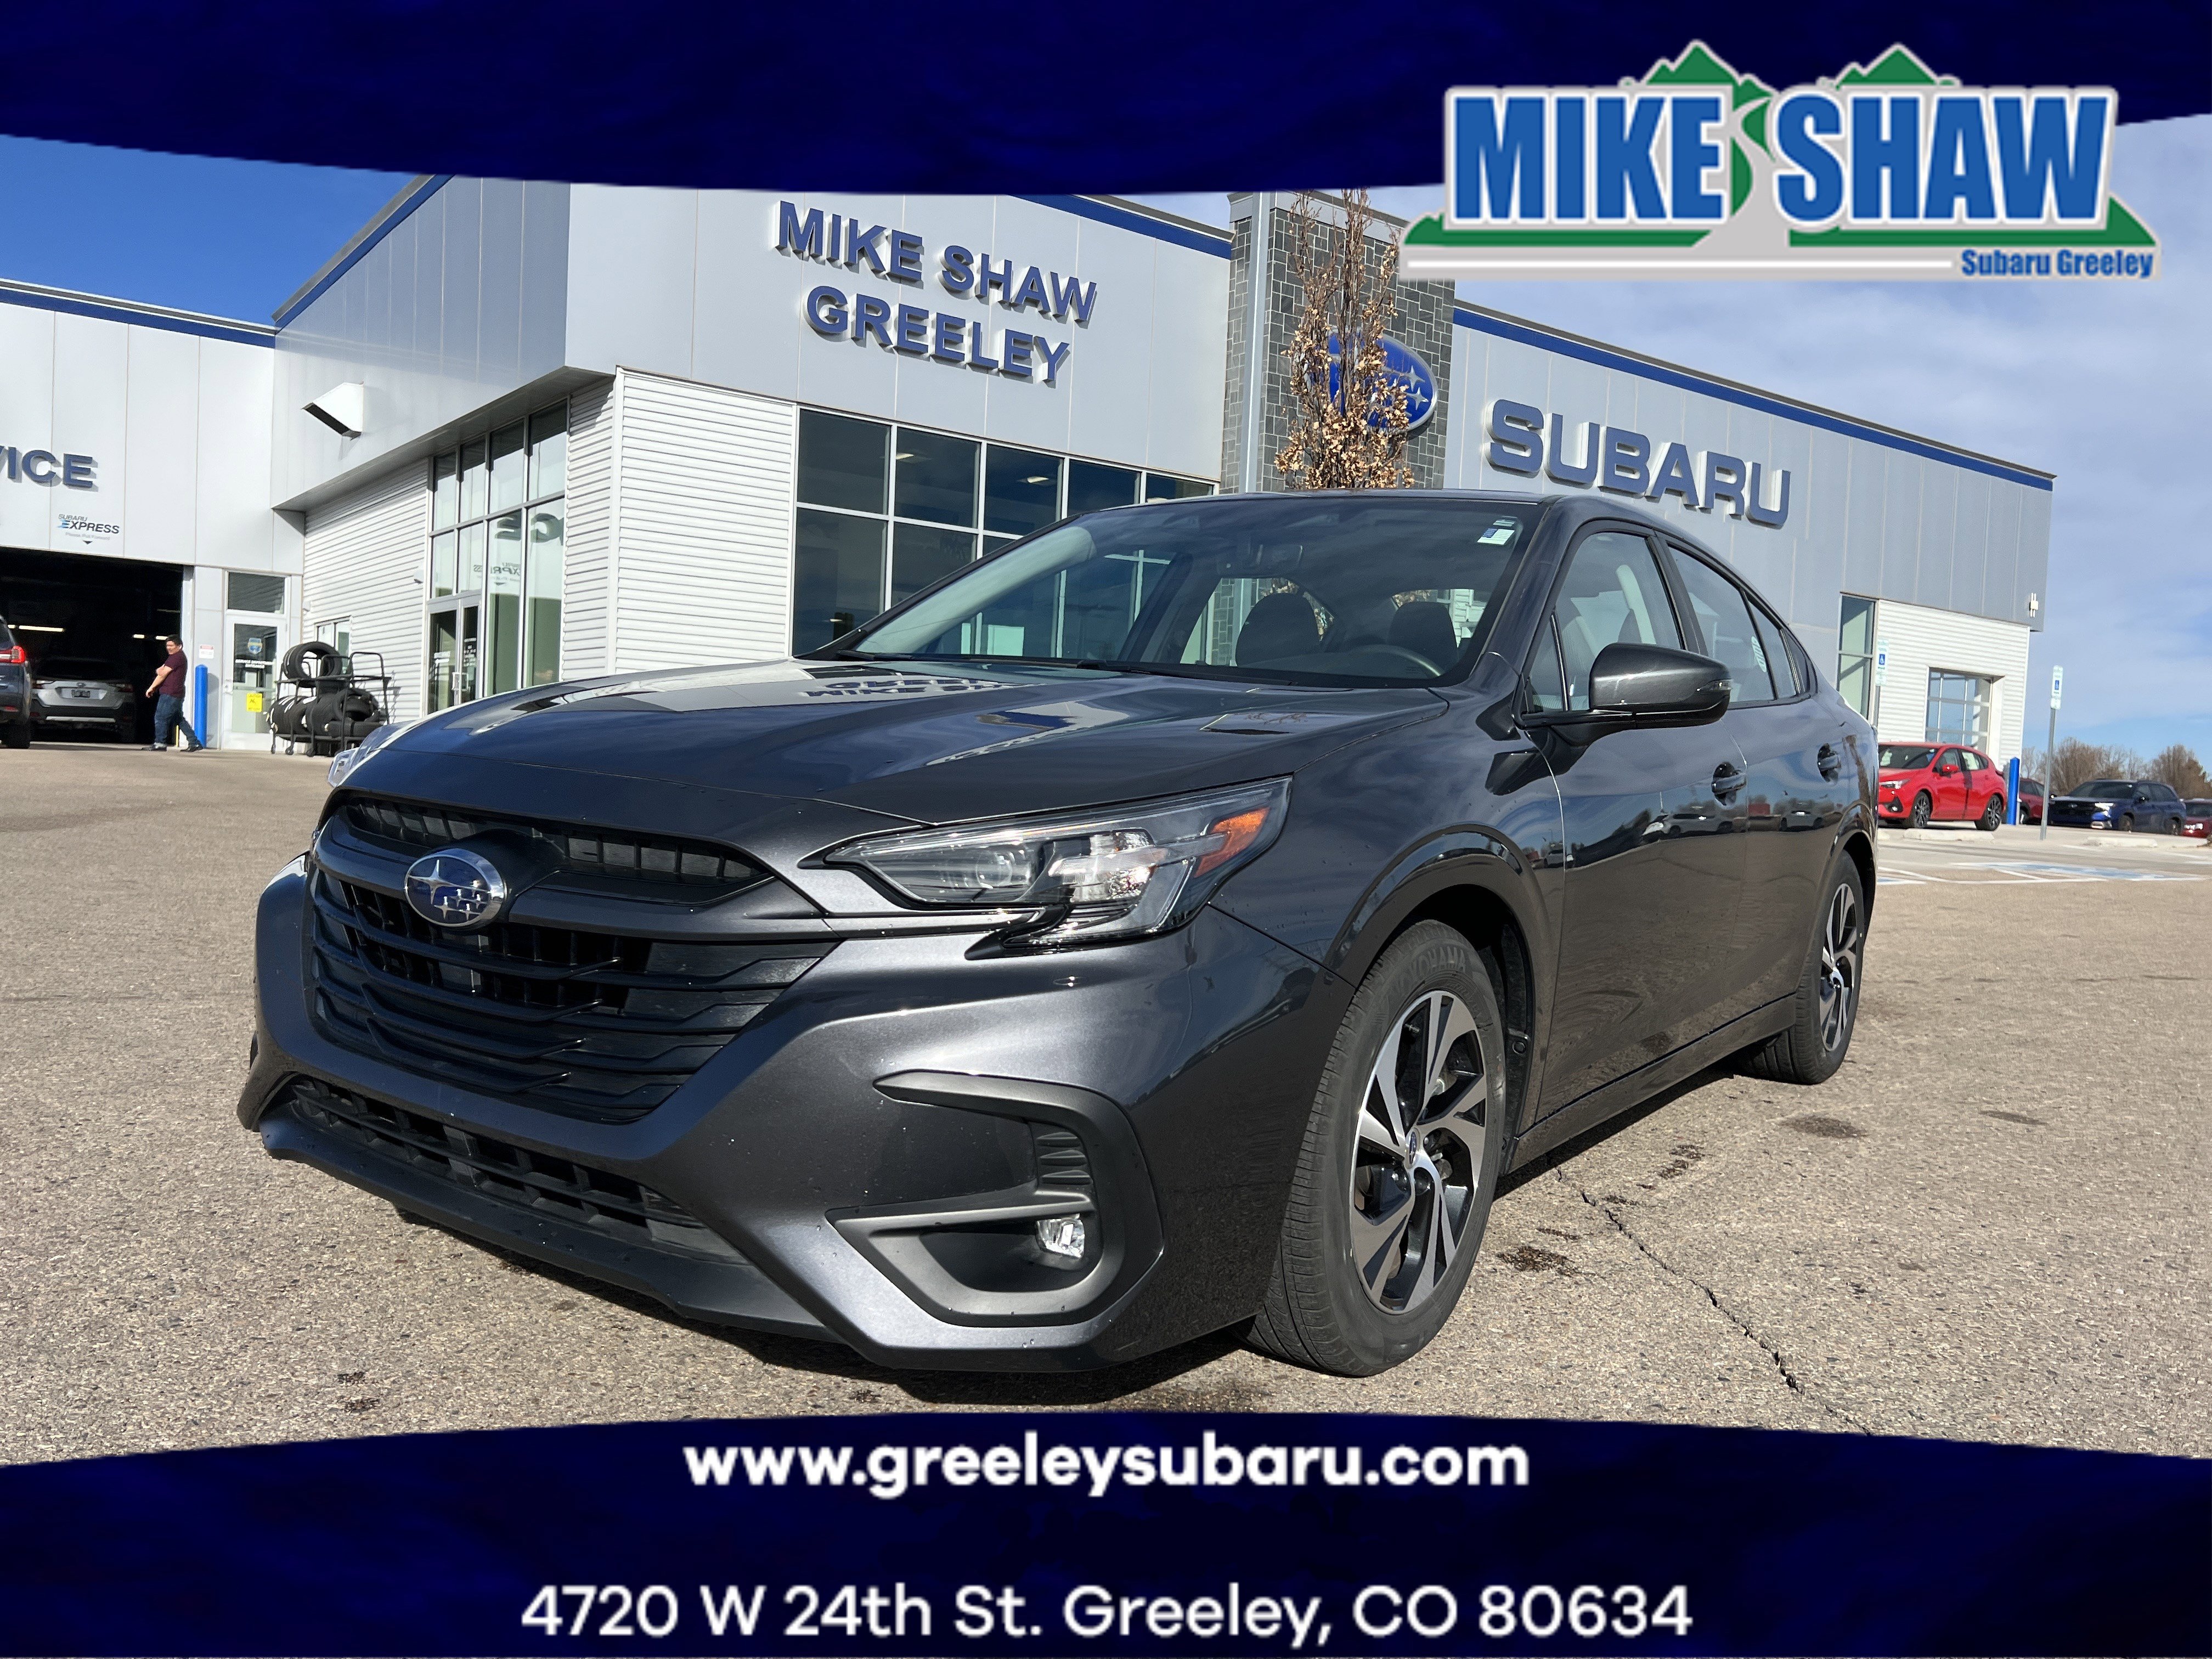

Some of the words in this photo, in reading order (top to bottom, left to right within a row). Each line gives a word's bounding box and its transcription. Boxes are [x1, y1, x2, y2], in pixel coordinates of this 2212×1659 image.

[775, 200, 923, 281] MIKE
[939, 245, 1097, 323] SHAW
[804, 285, 1070, 383] GREELEY
[0, 445, 93, 488] ICE
[1485, 399, 1791, 529] SUBARU
[58, 514, 88, 522] SUBARU
[60, 520, 120, 534] EXPRESS
